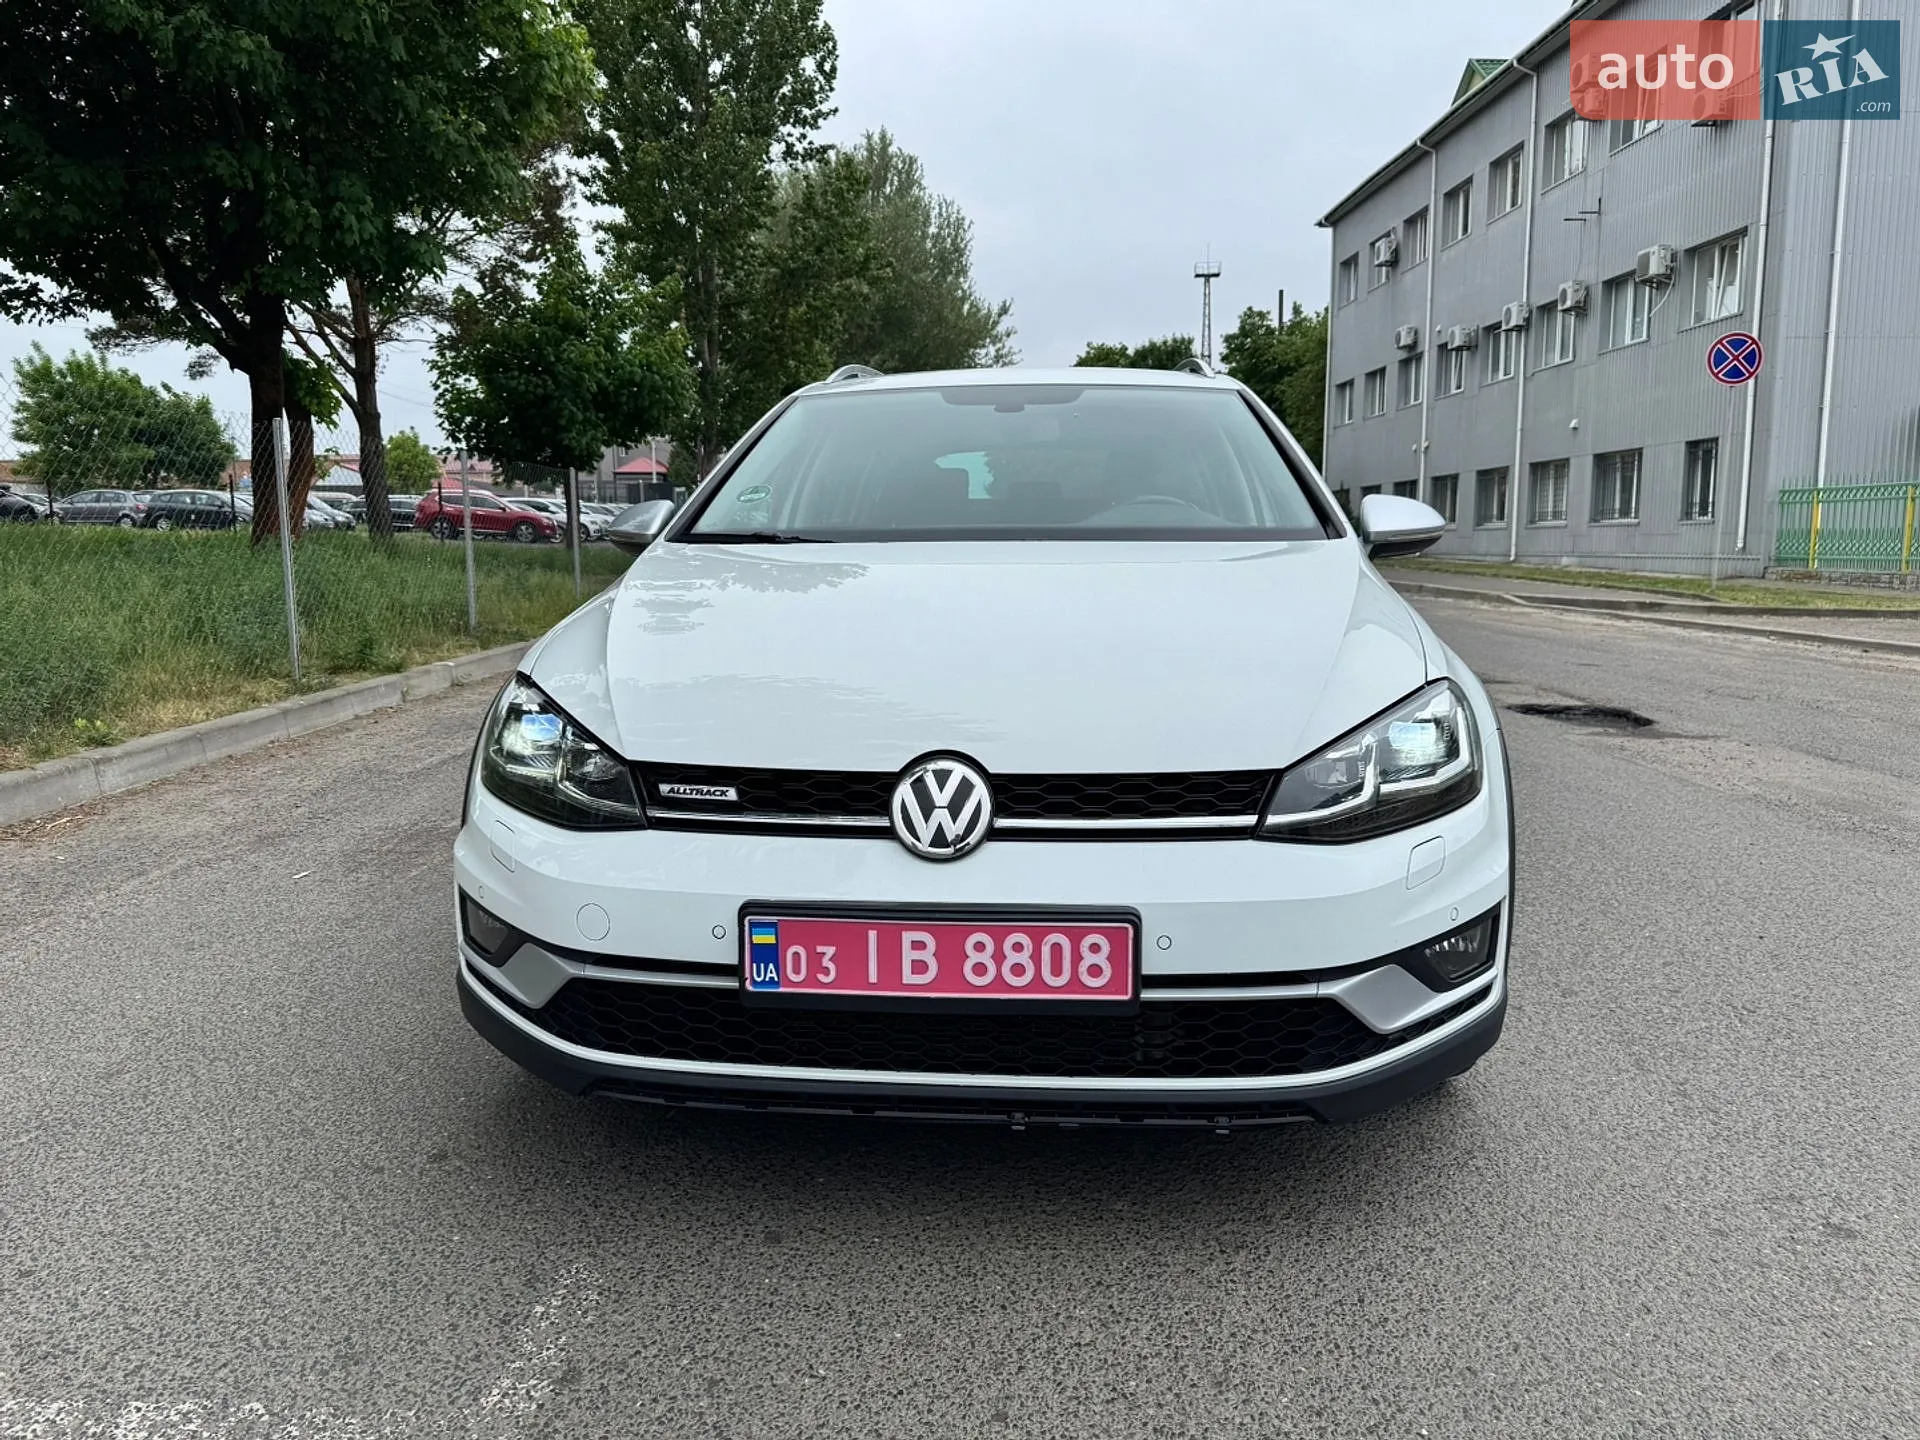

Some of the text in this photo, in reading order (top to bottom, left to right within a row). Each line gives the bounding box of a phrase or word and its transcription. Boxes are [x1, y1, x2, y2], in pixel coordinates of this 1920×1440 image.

[667, 786, 730, 797] ALLTRACK
[786, 945, 837, 984] 03
[962, 932, 1112, 988] 8808
[752, 962, 779, 982] UA
